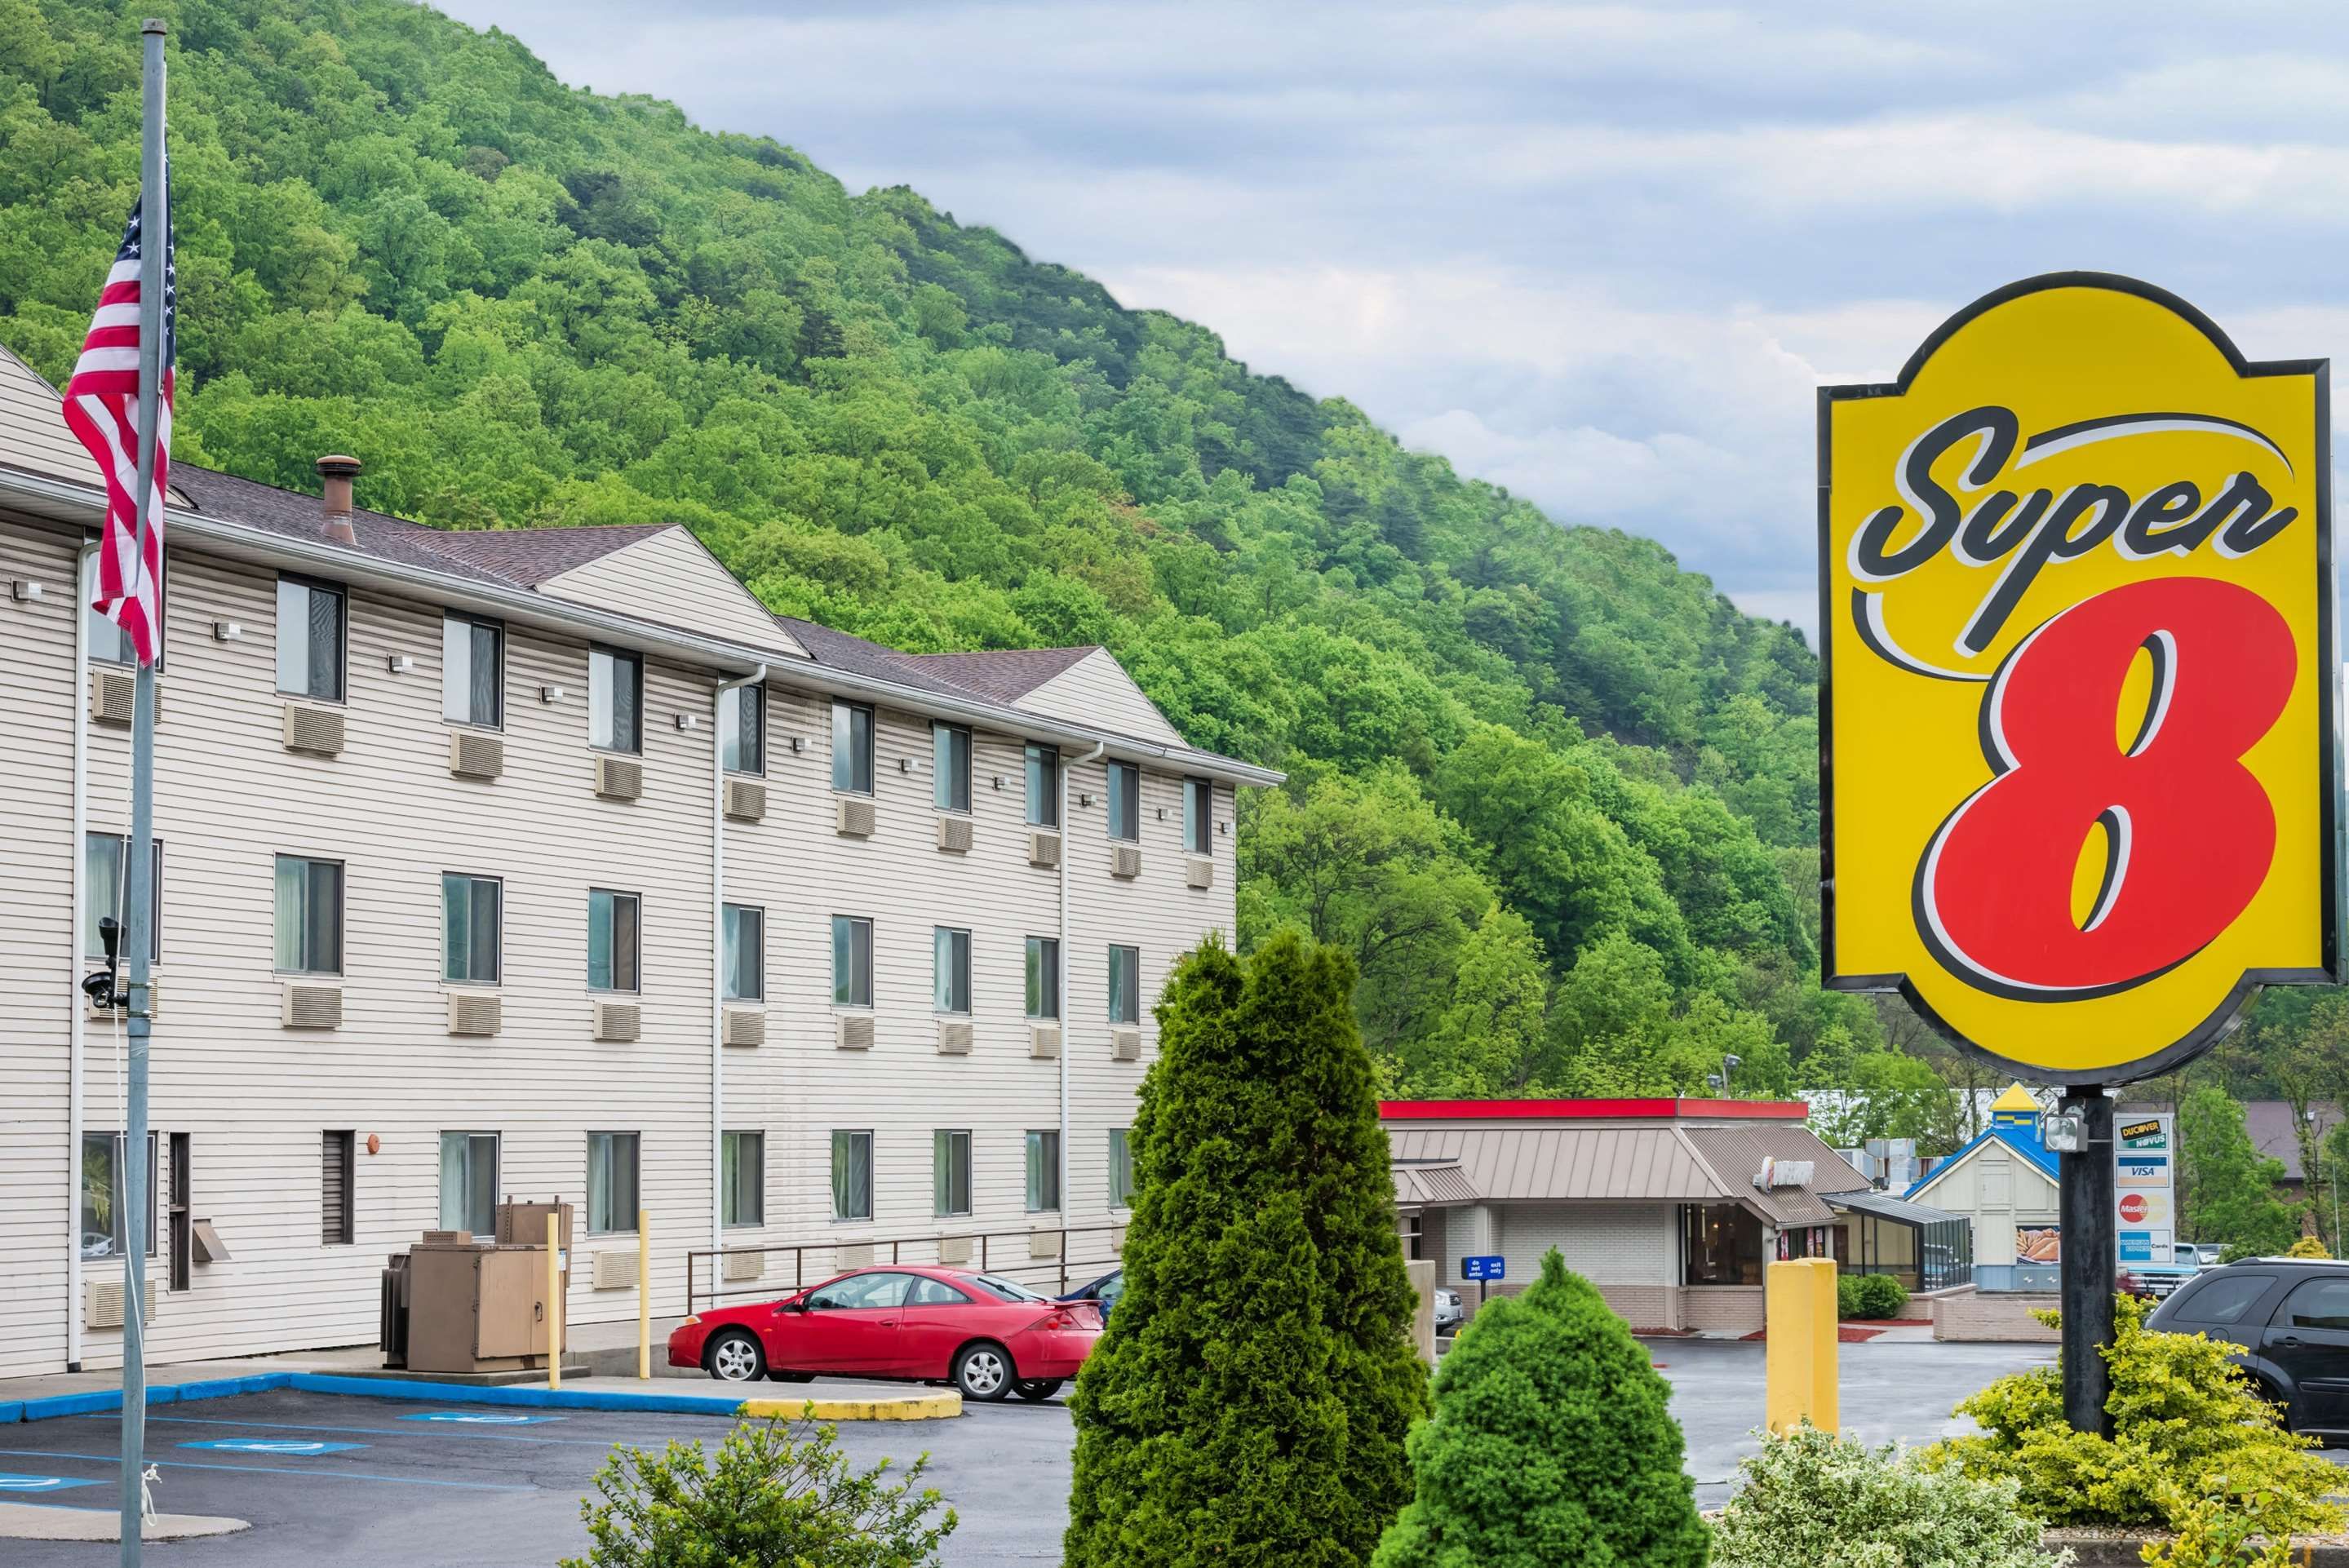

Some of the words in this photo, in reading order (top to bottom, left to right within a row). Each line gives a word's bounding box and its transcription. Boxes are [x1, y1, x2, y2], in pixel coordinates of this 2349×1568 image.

[1848, 405, 2298, 658] Super
[1912, 577, 2298, 1003] 8
[2122, 1122, 2159, 1136] DISCOVER
[2136, 1135, 2165, 1148] NOVUS
[2131, 1167, 2155, 1176] VISA
